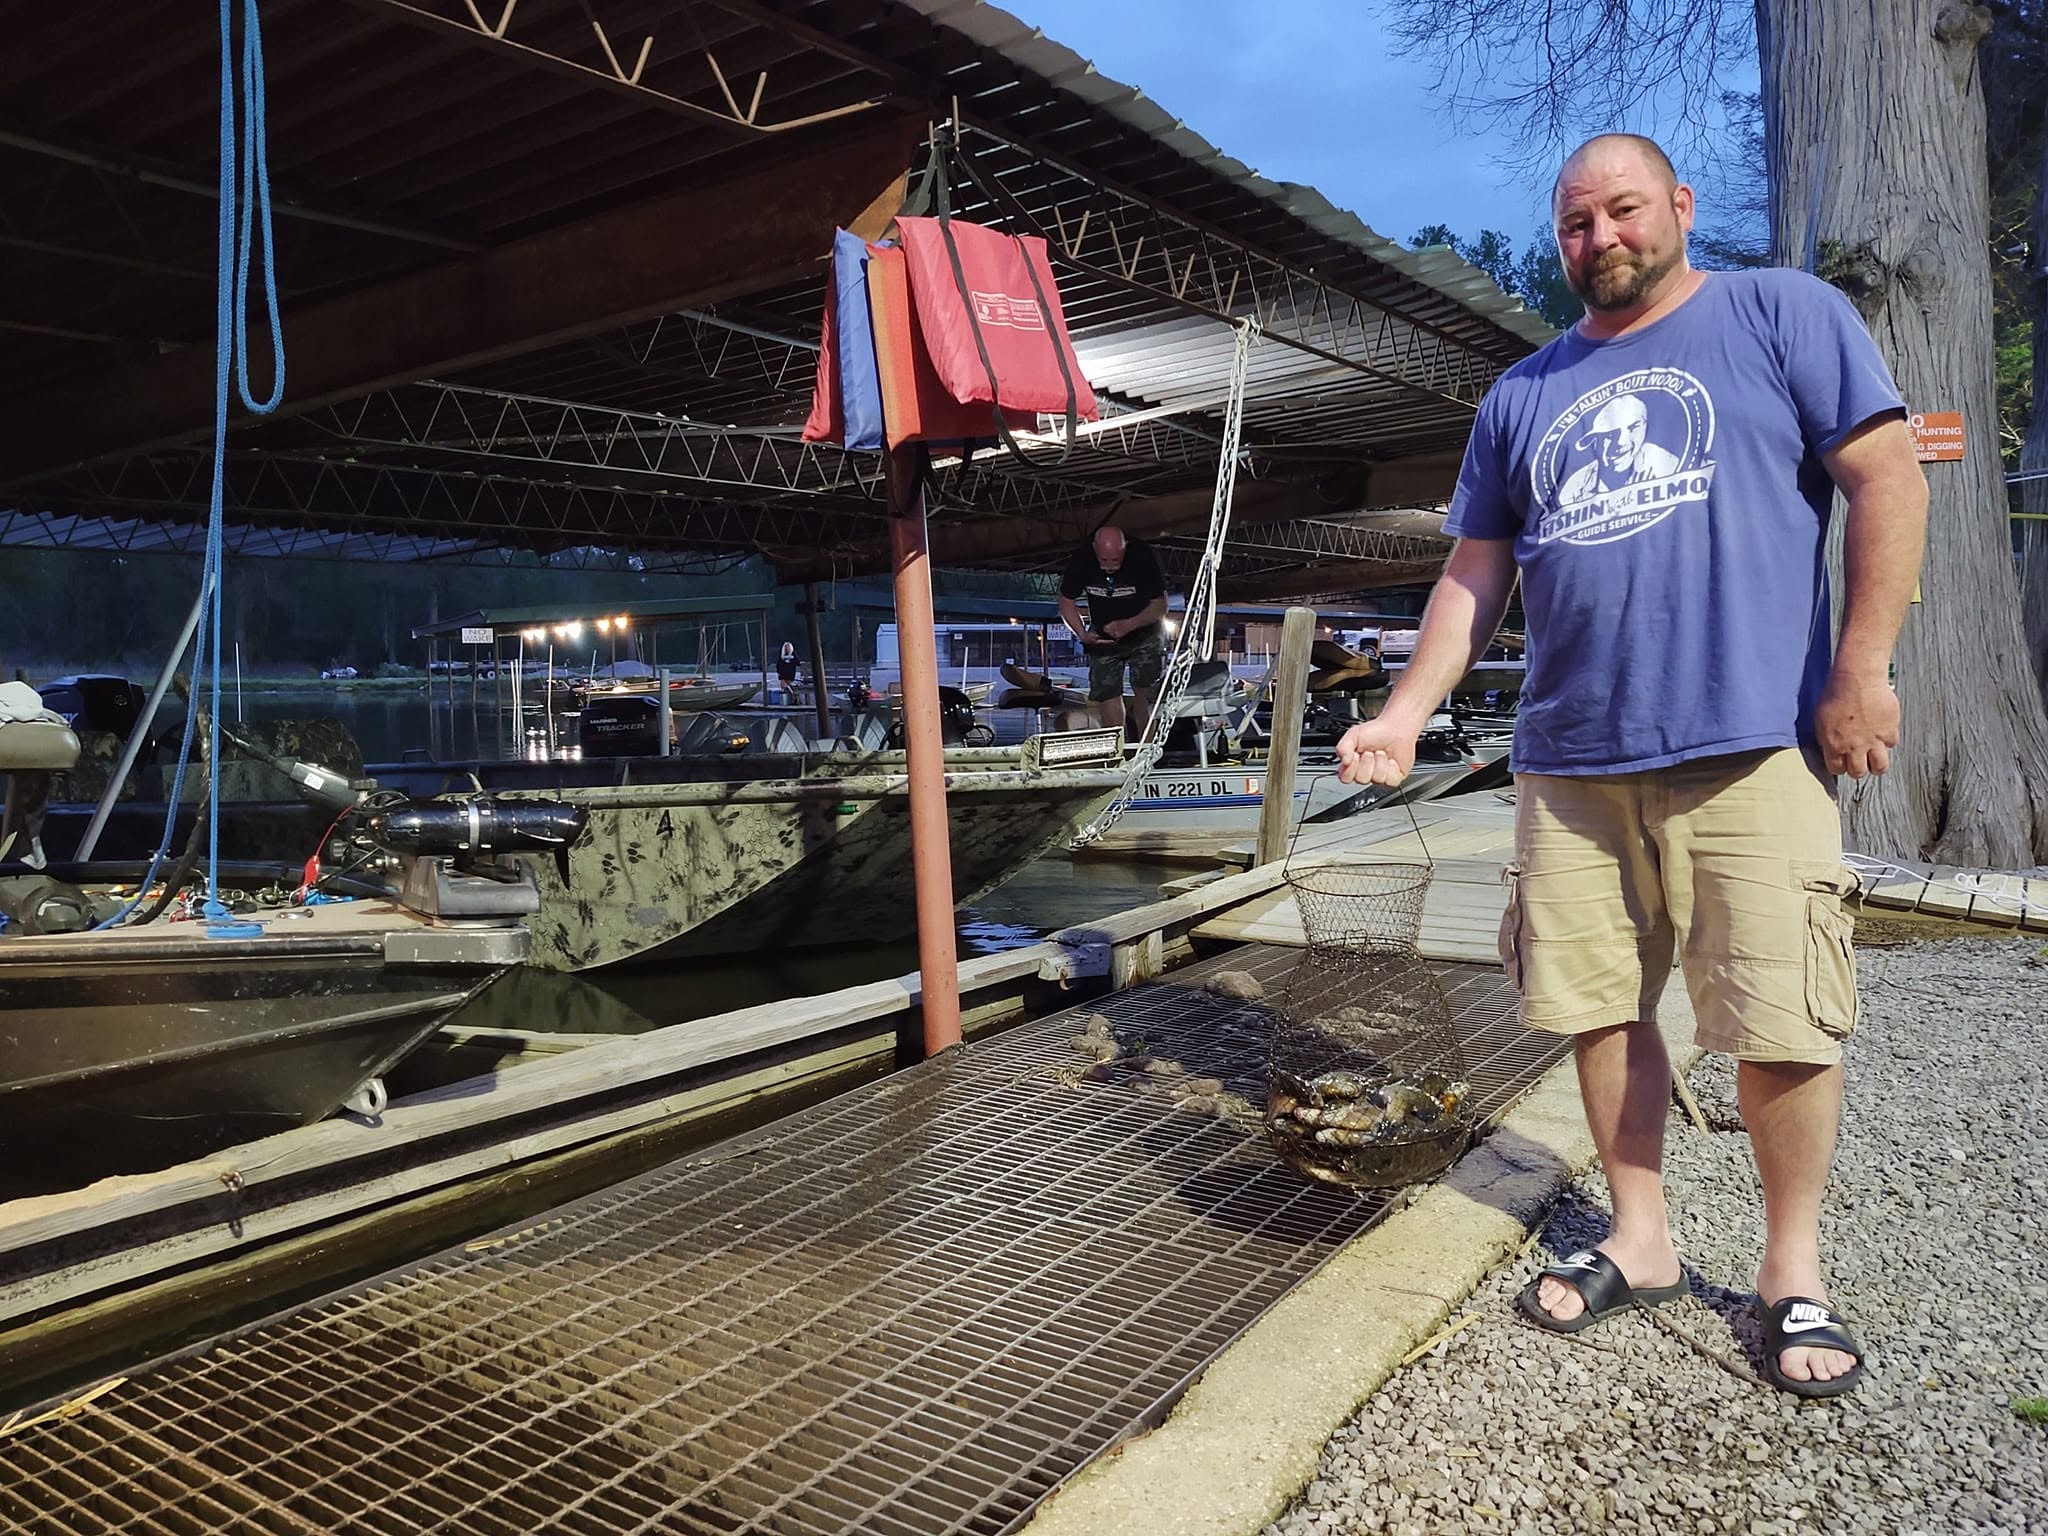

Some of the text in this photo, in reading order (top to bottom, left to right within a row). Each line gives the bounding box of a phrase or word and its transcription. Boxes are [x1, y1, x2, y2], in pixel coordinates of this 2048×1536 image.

[1616, 375, 1647, 393] BOUT
[1917, 427, 1962, 437] HUNTING
[1928, 442, 1963, 450] DIGGING
[1637, 477, 1708, 505] ELMO
[1578, 512, 1651, 539] GUIDE SERVICE
[596, 723, 645, 732] TRACKER
[1144, 781, 1232, 798] IN 2221 DL
[1790, 1303, 1830, 1322] NIKE
